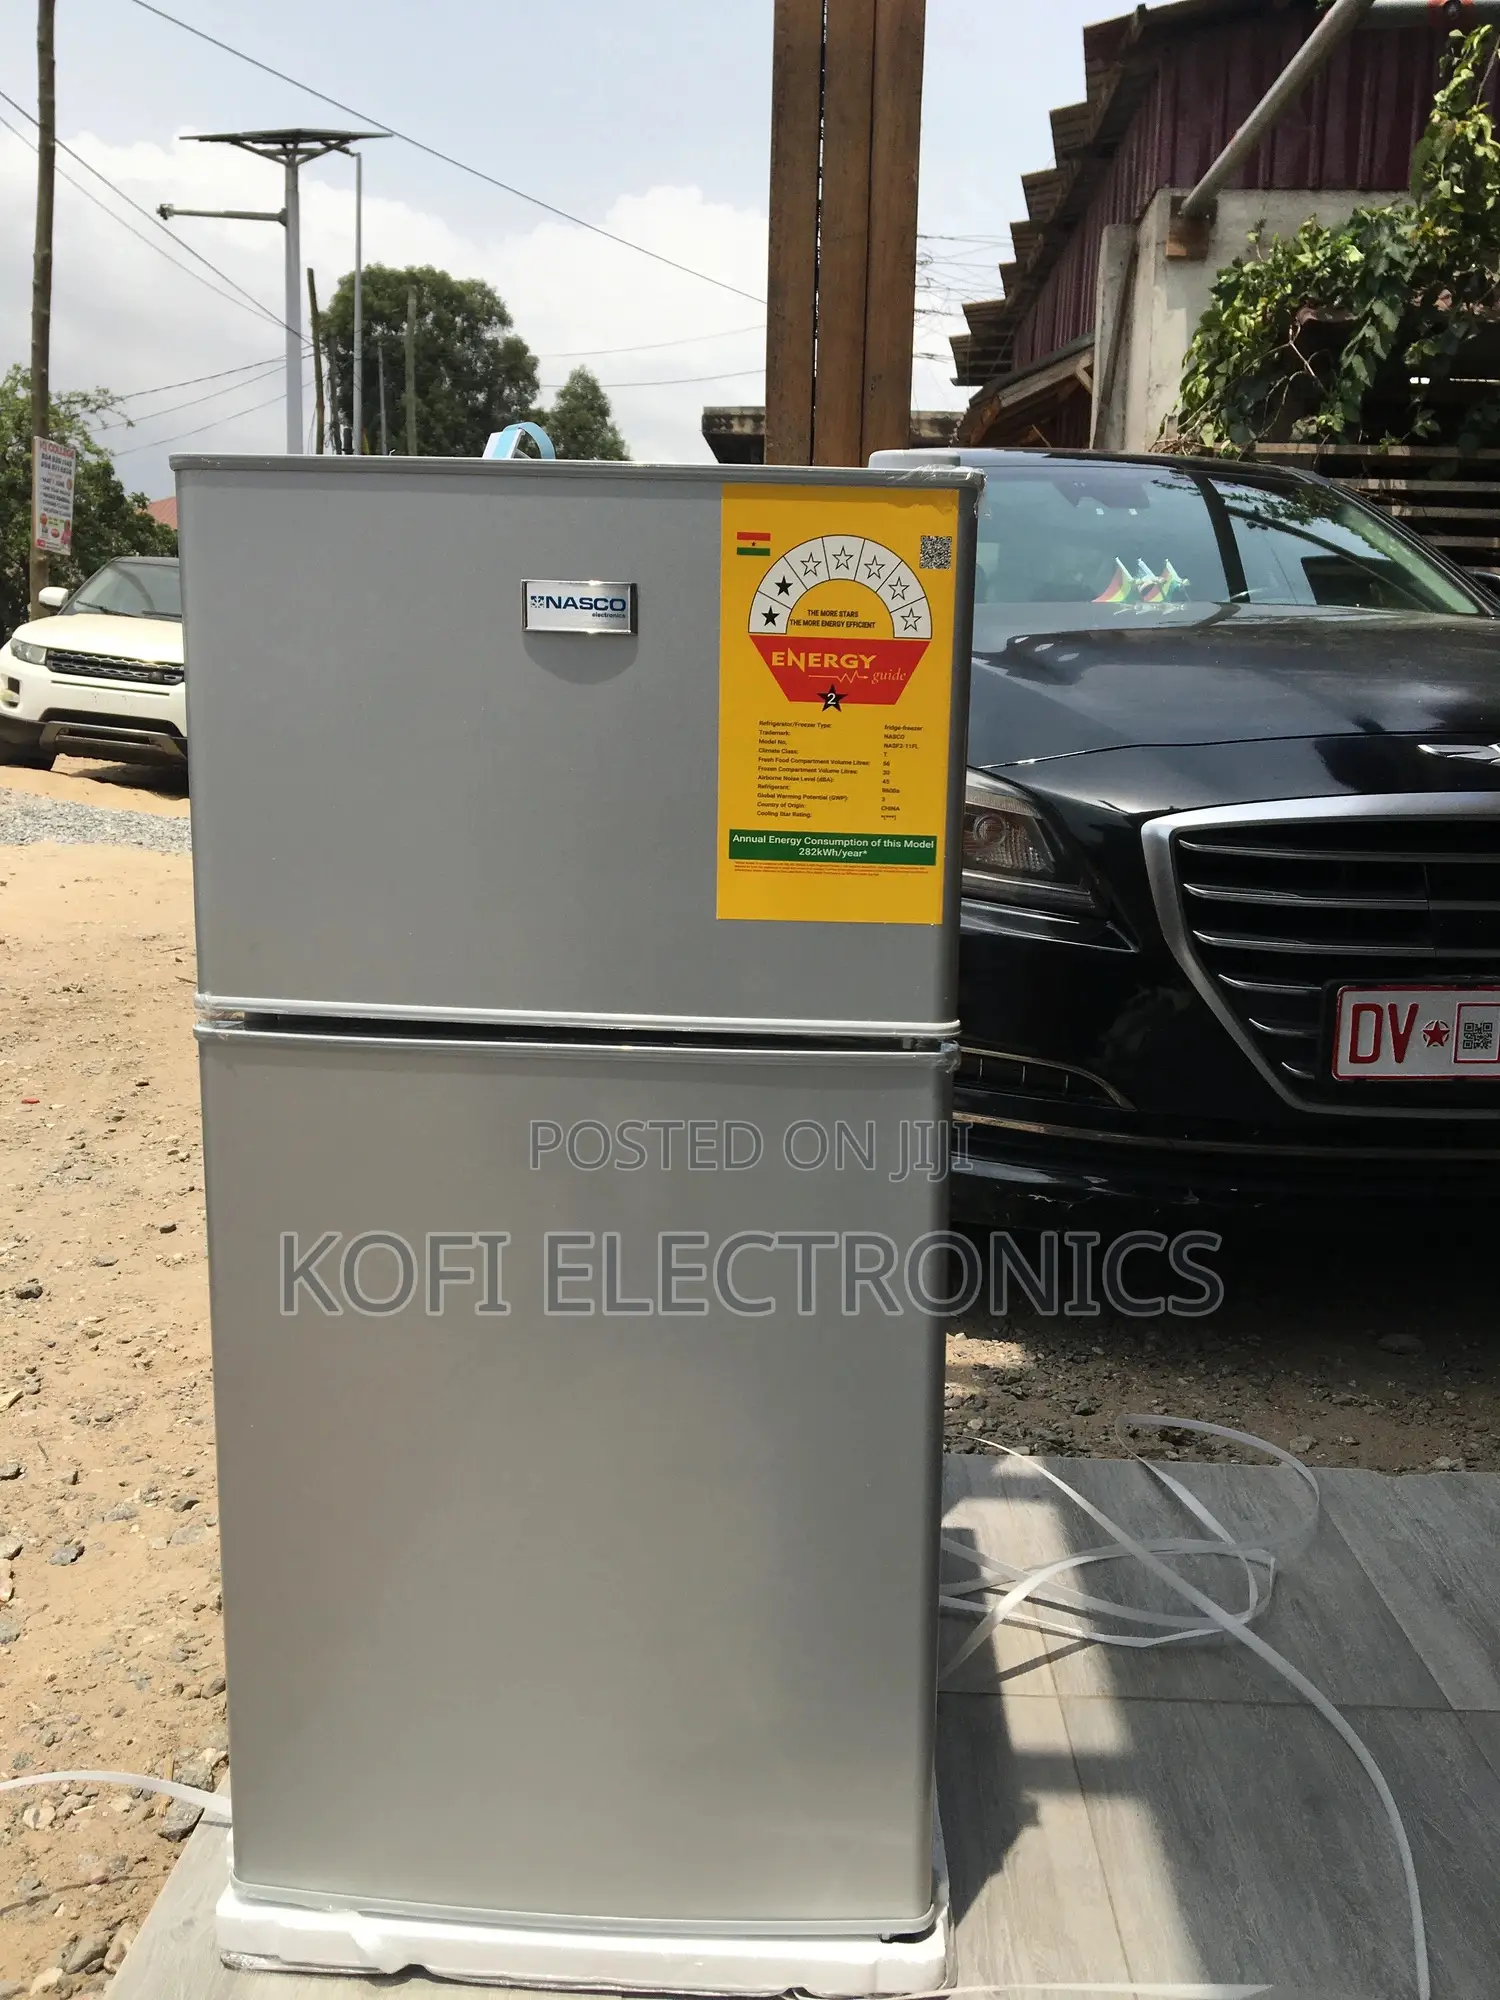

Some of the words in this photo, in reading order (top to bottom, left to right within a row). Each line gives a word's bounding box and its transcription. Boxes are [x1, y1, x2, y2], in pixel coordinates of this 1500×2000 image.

[546, 596, 626, 611] NASCO
[839, 610, 859, 618] STARS
[821, 620, 845, 628] ENERGY
[772, 648, 877, 672] ENERGY
[871, 668, 907, 684] guide
[827, 693, 836, 705] 2
[759, 720, 816, 728] Refrigerator/Freezer
[884, 724, 923, 732] fridge-freezer
[732, 834, 767, 844] Annual
[768, 835, 802, 847] Energy
[804, 836, 868, 848] Consumption
[870, 838, 882, 847] of
[883, 838, 902, 848] this
[904, 839, 934, 849] Model
[1349, 1002, 1420, 1064] DV
